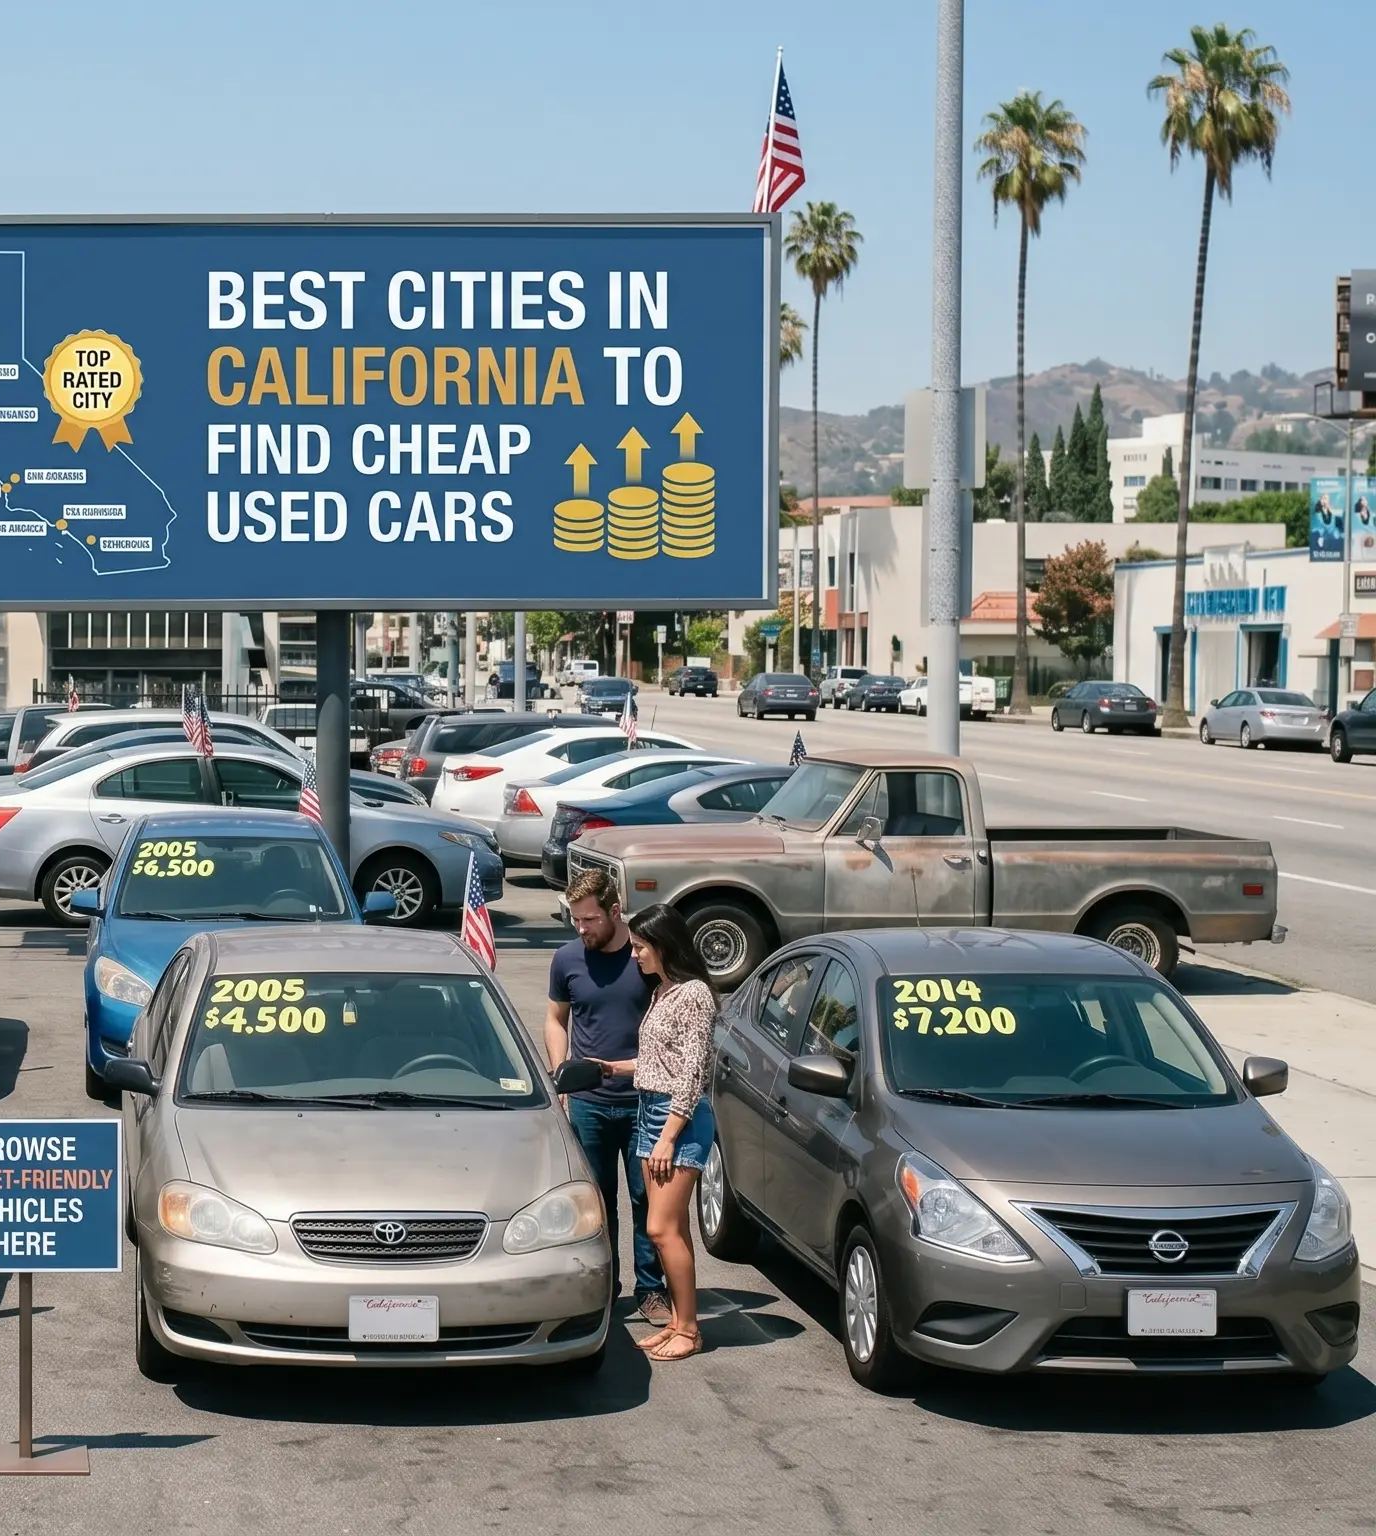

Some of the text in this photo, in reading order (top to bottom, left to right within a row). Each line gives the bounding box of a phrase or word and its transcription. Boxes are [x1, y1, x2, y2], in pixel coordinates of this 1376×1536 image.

[207, 270, 669, 330] BEST CITIES IN
[75, 350, 111, 367] TOP
[63, 371, 122, 389] RATED
[206, 346, 684, 406] CALIFORNIA TO
[72, 391, 113, 409] CITY
[207, 423, 532, 475] FIND CHEAP
[206, 490, 514, 542] USED CARS
[138, 841, 197, 858] 2005
[210, 978, 305, 1003] 2005
[892, 978, 982, 1003] 2014
